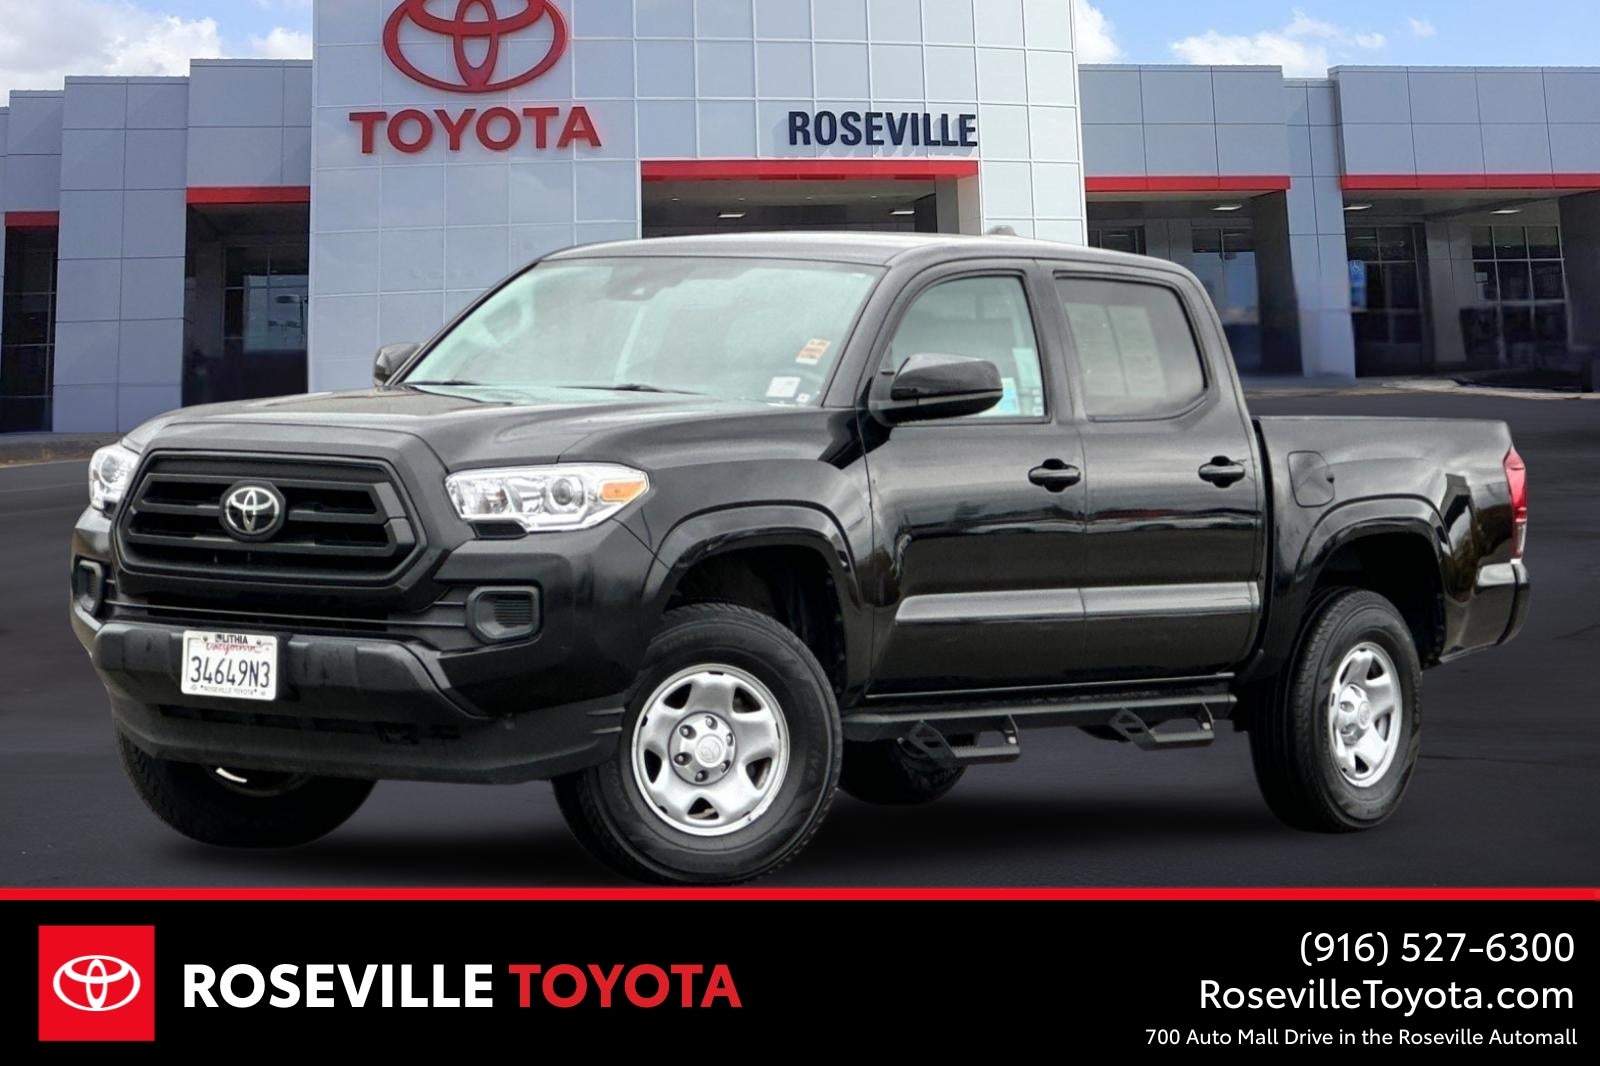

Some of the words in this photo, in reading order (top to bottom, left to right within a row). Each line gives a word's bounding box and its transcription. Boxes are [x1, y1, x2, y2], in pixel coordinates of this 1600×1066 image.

[349, 106, 602, 154] TOYOTA
[788, 110, 978, 148] ROSEVILLE
[223, 634, 248, 645] LITHIA
[190, 656, 270, 688] 34649N3
